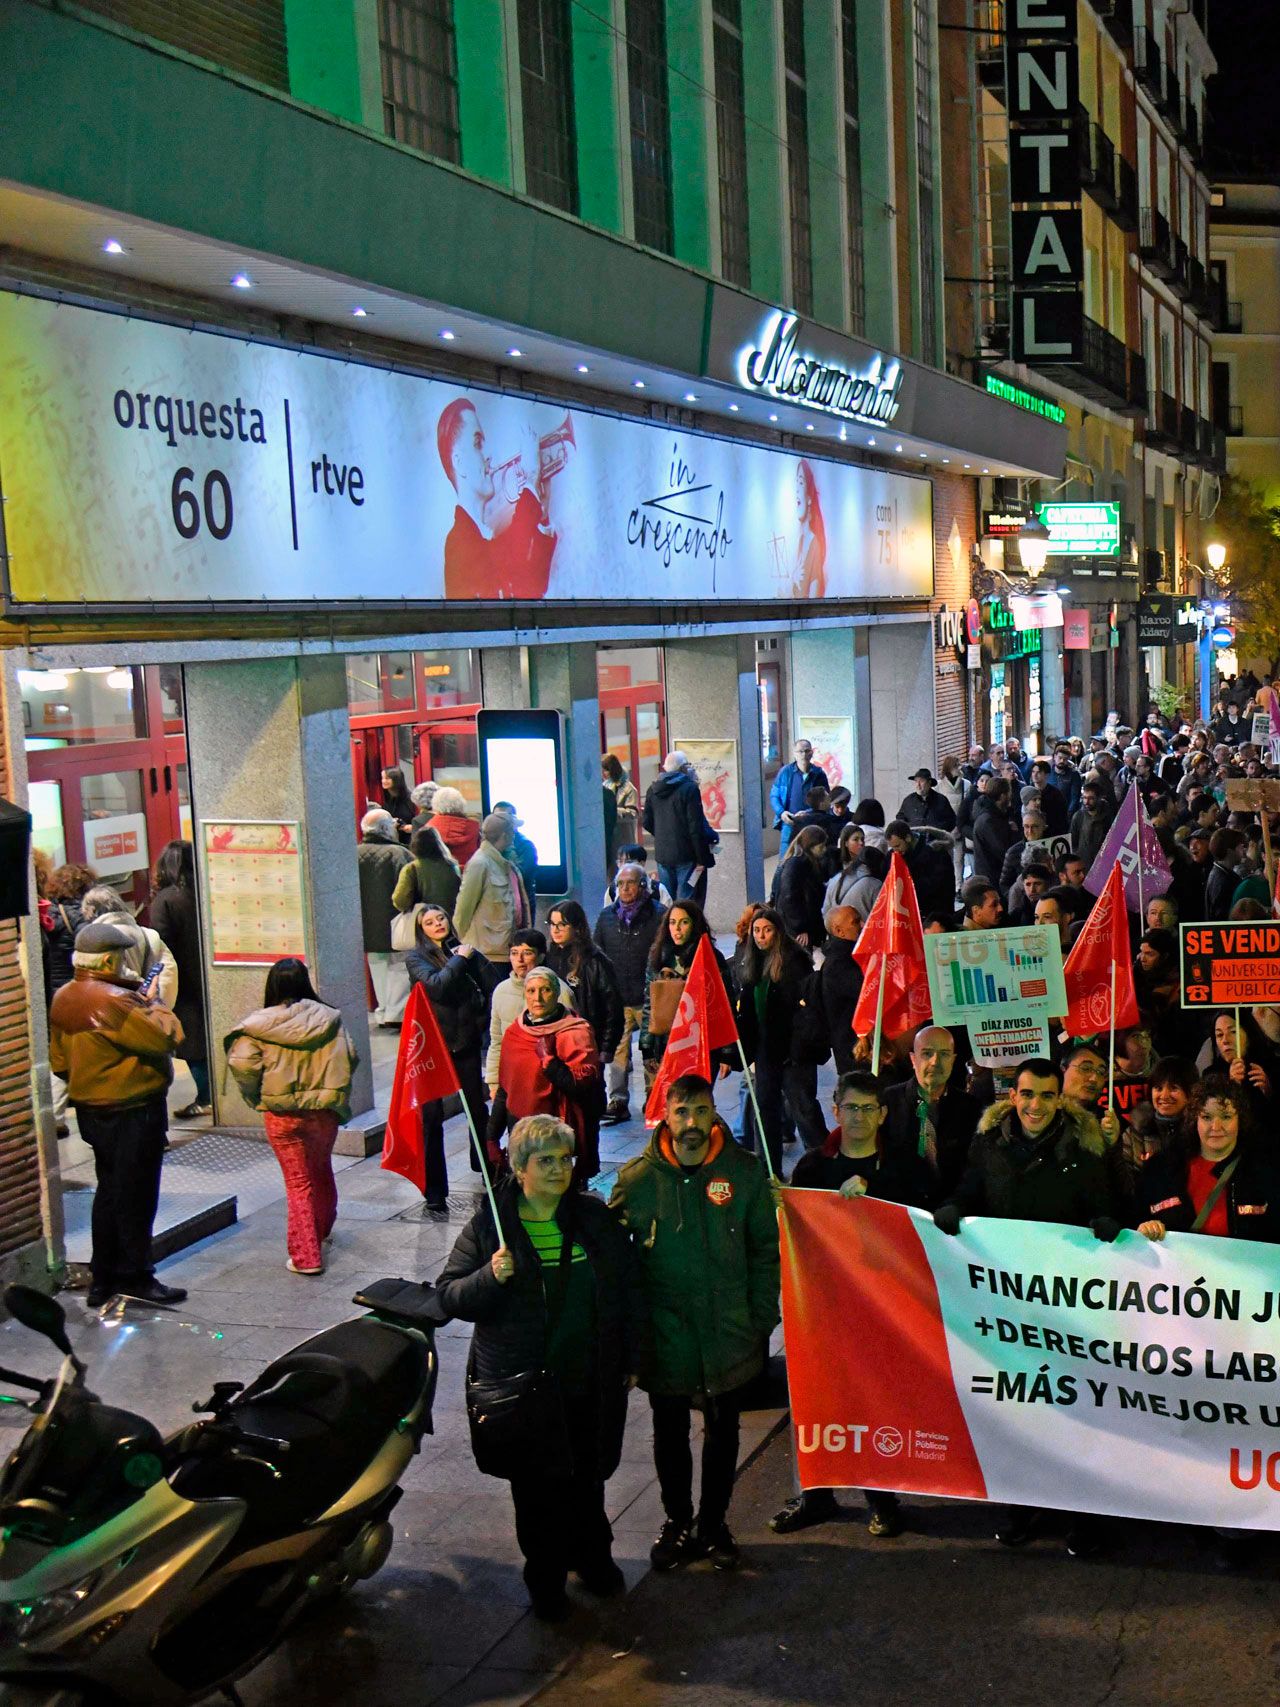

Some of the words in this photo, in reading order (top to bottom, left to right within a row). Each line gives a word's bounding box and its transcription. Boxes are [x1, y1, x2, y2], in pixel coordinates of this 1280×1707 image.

[742, 312, 905, 422] Monumental
[113, 388, 267, 446] orquesta
[310, 453, 365, 506] rtve
[668, 443, 696, 486] in
[171, 466, 234, 540] 60
[876, 504, 893, 523] coro
[626, 490, 732, 593] crescendo
[877, 530, 893, 565] 75
[1140, 615, 1171, 625] Marco
[1186, 930, 1214, 955] SE
[981, 1018, 1002, 1032] DÍAZ
[1003, 1017, 1034, 1030] AYUSO
[981, 1047, 992, 1057] LA
[993, 1047, 1002, 1058] U.
[709, 1181, 731, 1196] UGT
[967, 1263, 1242, 1321] FINANCIACIÓN
[974, 1316, 1193, 1378] +DERECHOS
[971, 1363, 1077, 1407] =MÁS
[1086, 1378, 1109, 1407] Y
[1119, 1387, 1248, 1425] MEJOR
[798, 1423, 869, 1454] UGT
[915, 1430, 950, 1442] Servicios
[915, 1440, 948, 1451] Públicos
[915, 1450, 946, 1462] Madrid
